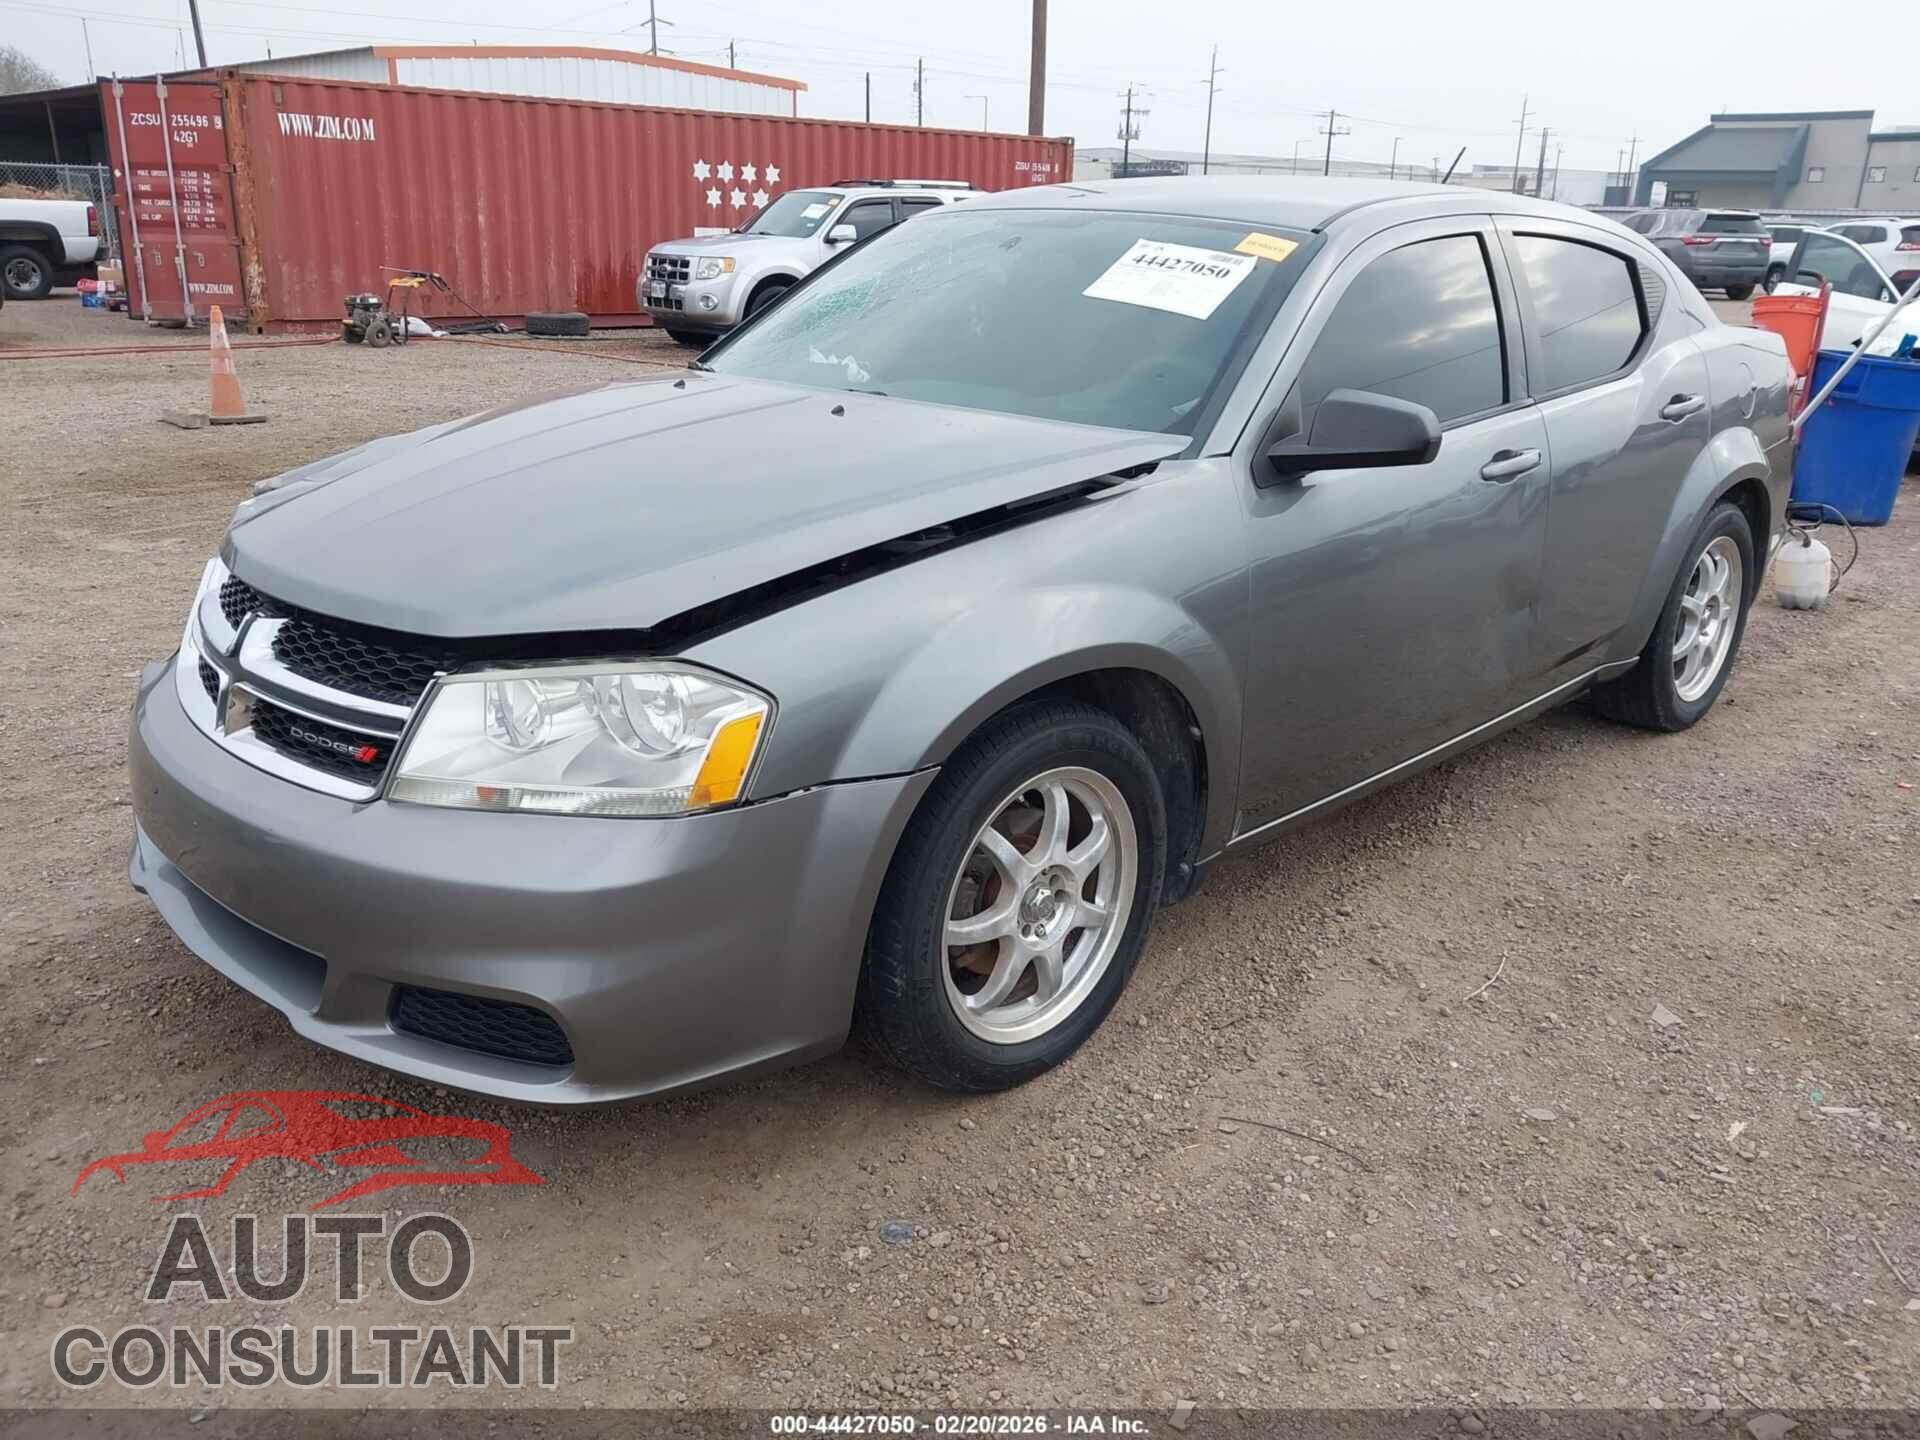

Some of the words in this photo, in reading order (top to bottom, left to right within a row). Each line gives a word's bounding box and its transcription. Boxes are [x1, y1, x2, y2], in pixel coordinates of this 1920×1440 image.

[130, 113, 160, 125] ZCSU
[174, 130, 198, 143] 42G1
[1132, 253, 1231, 278] 44427050
[290, 726, 362, 755] DODGE
